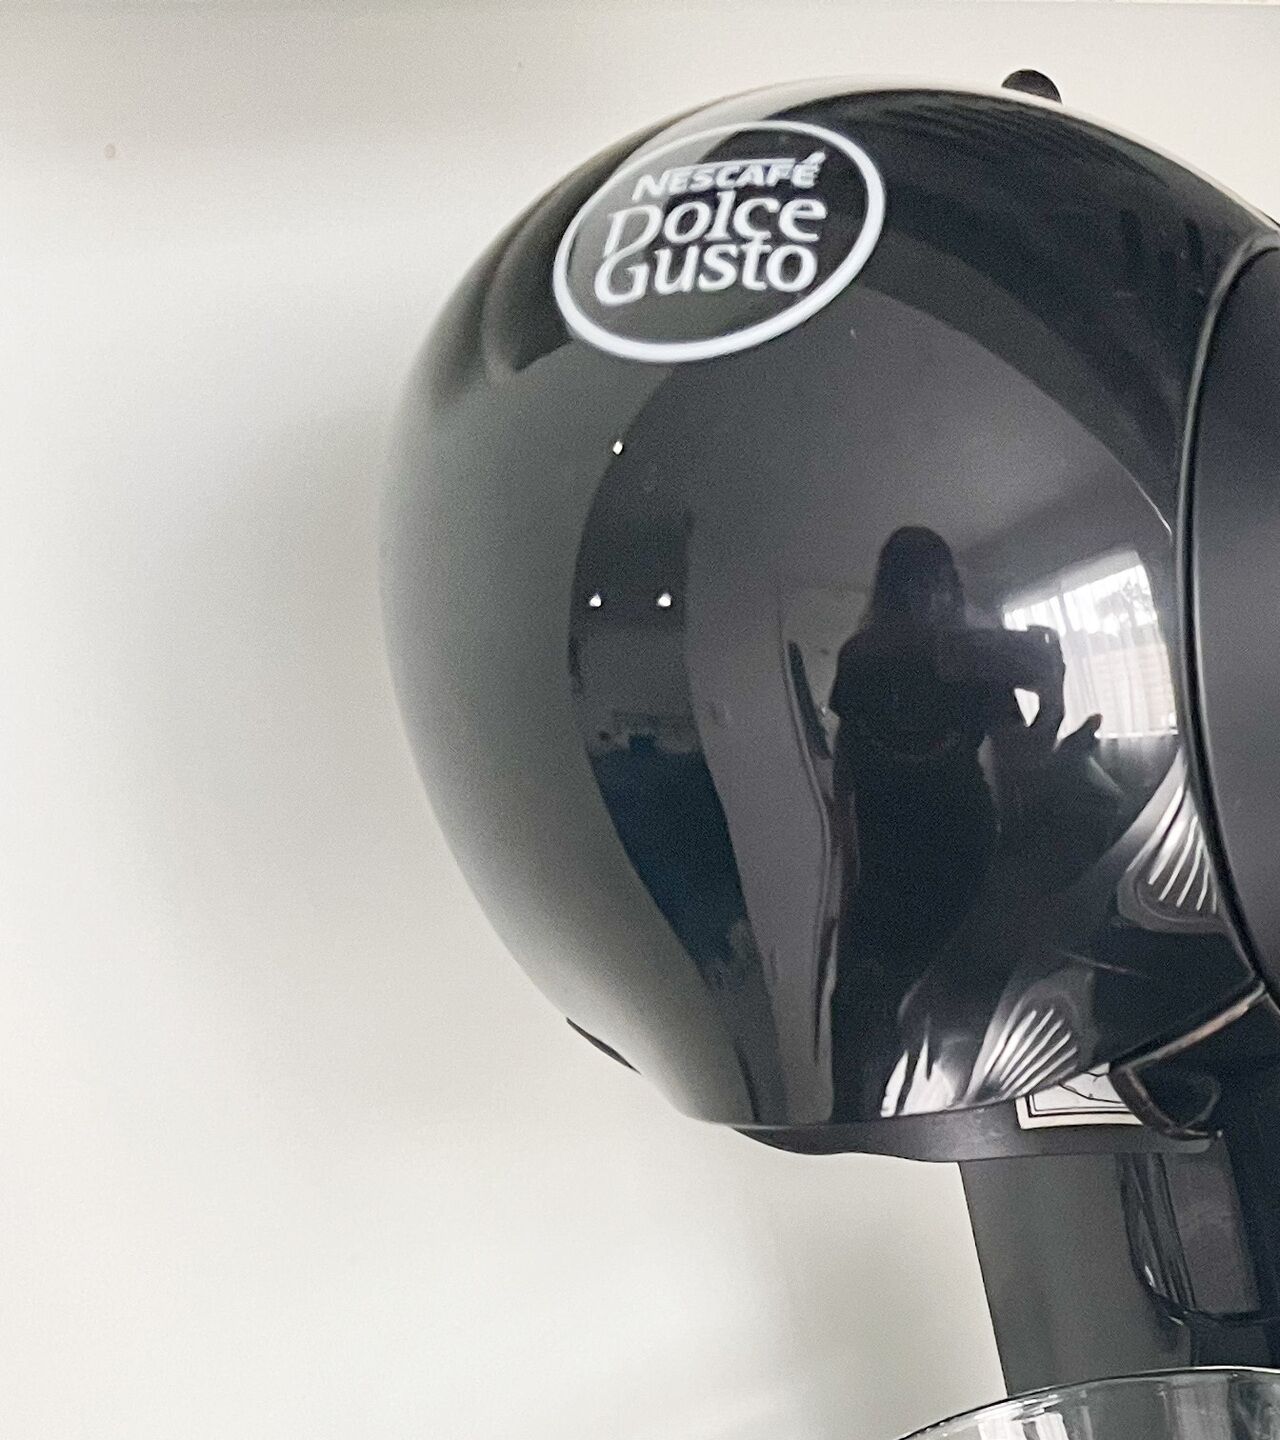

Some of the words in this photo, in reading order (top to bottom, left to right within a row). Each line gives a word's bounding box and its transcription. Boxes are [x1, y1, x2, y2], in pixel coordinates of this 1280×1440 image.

[631, 150, 827, 201] NESCAFÉ
[604, 189, 828, 258] Dolce
[593, 242, 818, 306] Gusto
